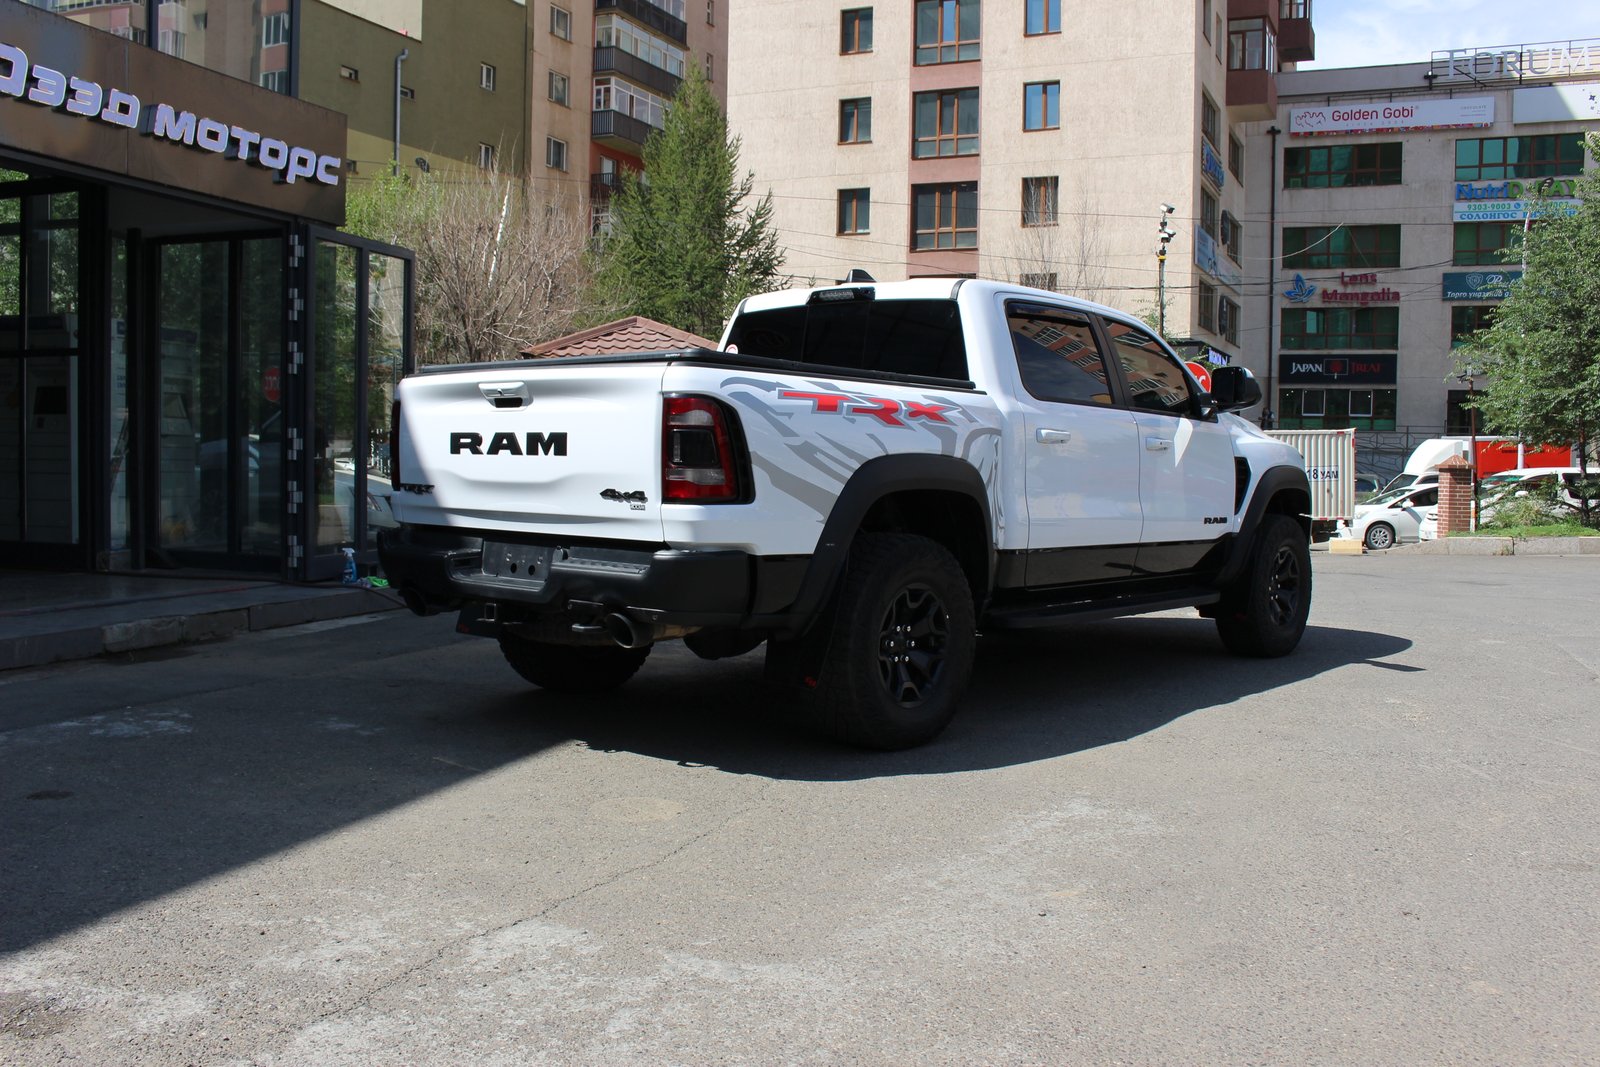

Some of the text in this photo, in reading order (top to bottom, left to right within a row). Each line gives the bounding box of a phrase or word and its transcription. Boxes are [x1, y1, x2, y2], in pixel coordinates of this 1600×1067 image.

[1447, 44, 1594, 80] FORUM
[1331, 105, 1414, 122] Golden Gobi
[1466, 202, 1511, 211] 9303-9003
[1459, 211, 1518, 220] СОЛОНГОС
[1341, 271, 1377, 286] Lens
[1321, 288, 1400, 305] Mongolia
[1290, 362, 1323, 374] JAPAN
[781, 389, 955, 430] TRX
[450, 431, 568, 457] RAM
[1306, 468, 1319, 480] 18
[1203, 516, 1228, 525] RAM
